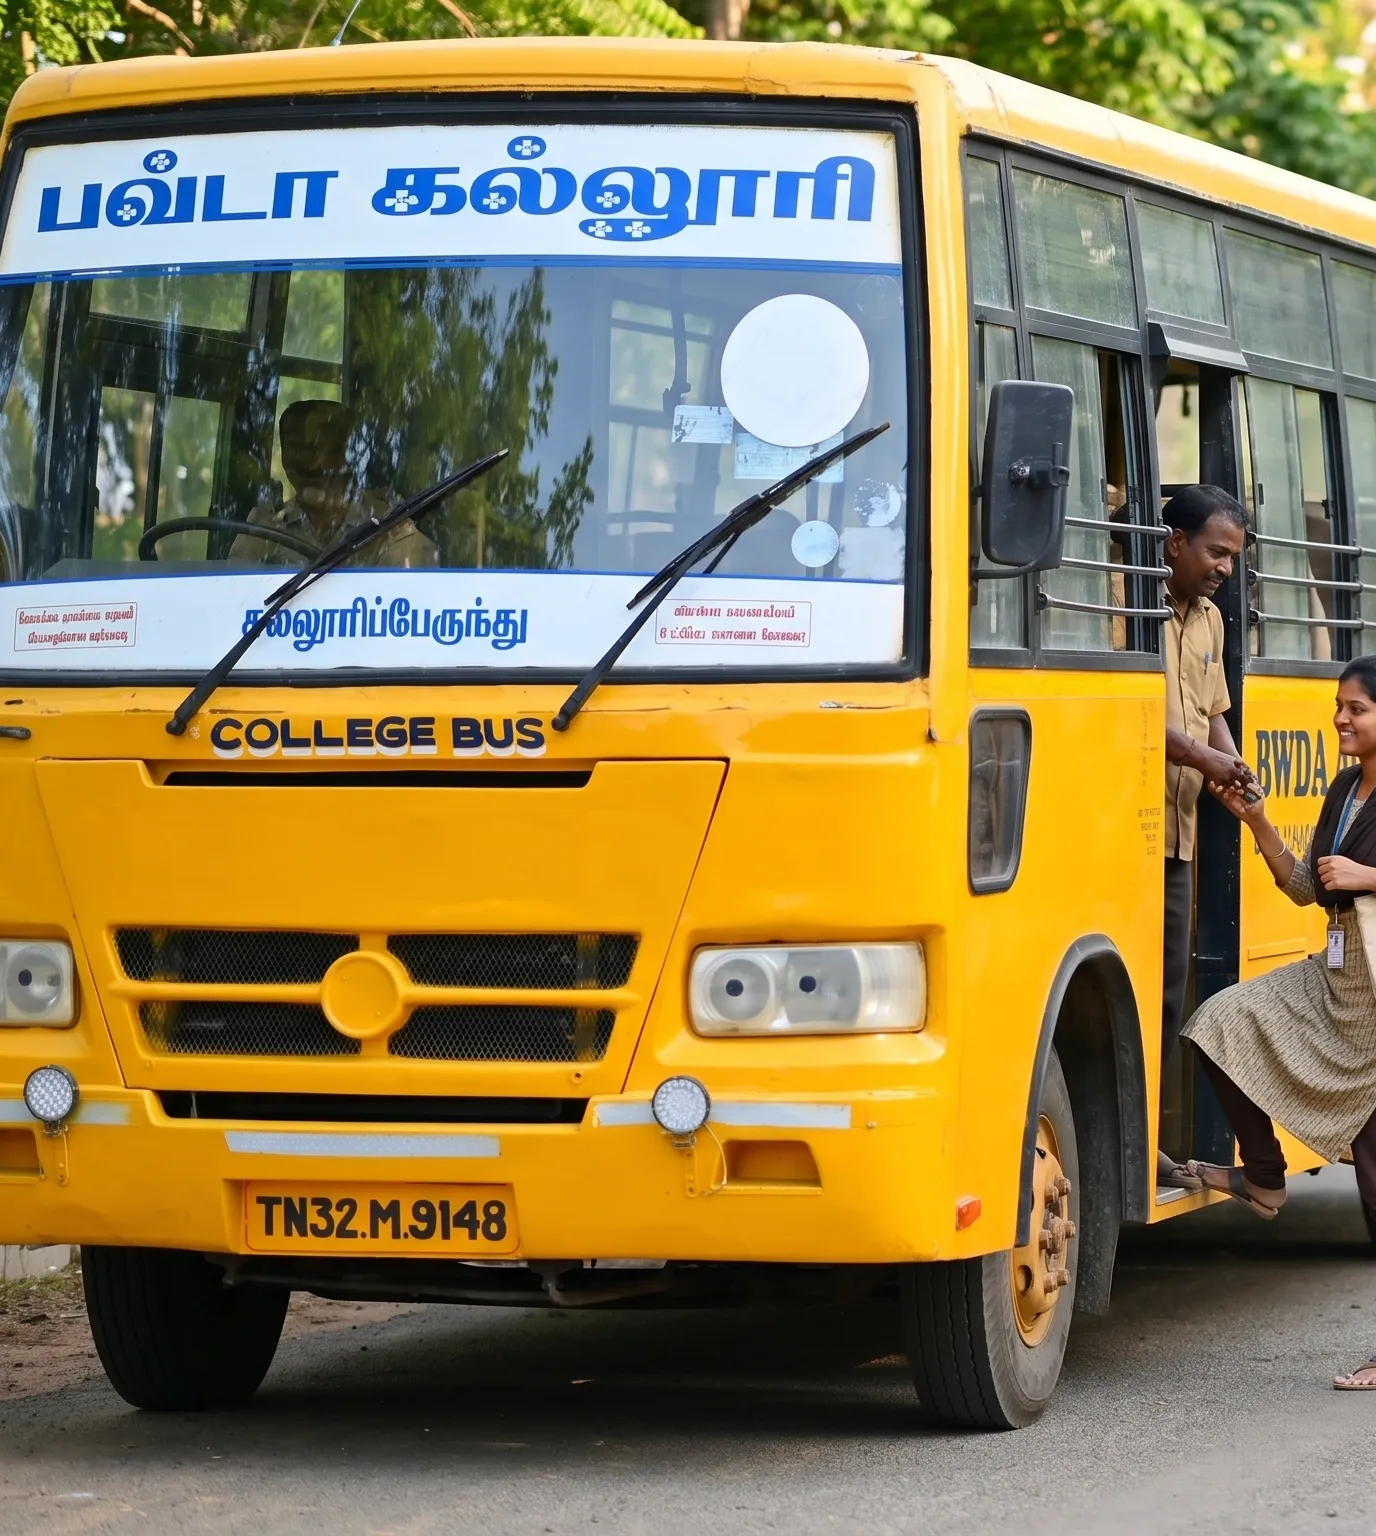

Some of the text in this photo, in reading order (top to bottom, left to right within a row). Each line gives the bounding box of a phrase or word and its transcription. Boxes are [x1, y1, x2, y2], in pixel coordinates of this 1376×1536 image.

[38, 136, 876, 241] பவ்டா கல்லூரி
[210, 716, 546, 751] COLLEGE BUS
[1255, 729, 1328, 798] BWDA
[256, 1196, 507, 1241] TN32.M.9148
